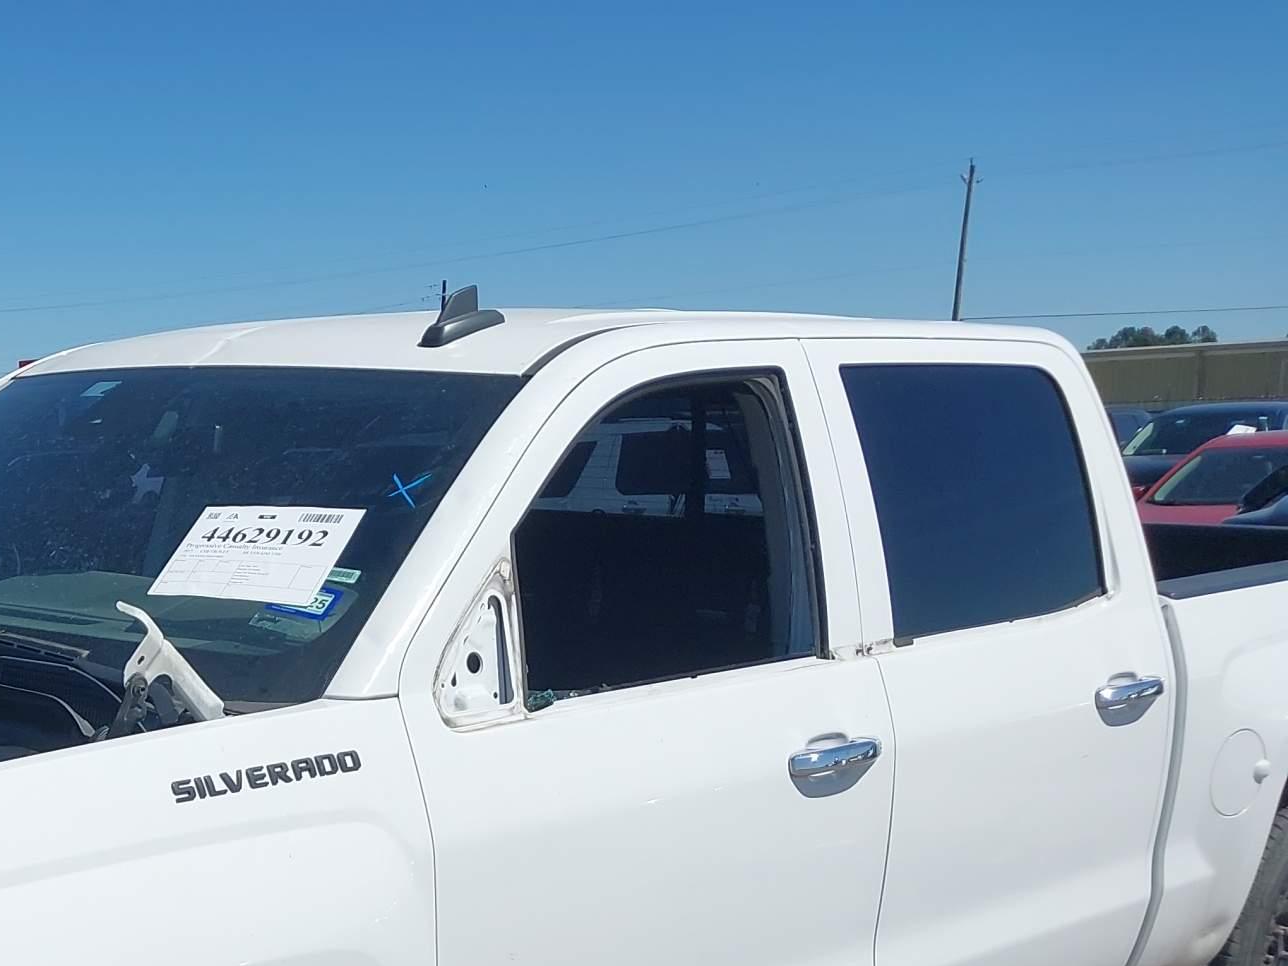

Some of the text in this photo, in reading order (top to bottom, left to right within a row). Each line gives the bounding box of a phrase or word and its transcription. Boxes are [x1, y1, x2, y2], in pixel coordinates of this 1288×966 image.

[201, 525, 329, 547] 44629192
[223, 543, 251, 551] Casualty
[171, 750, 362, 803] SILVERADO
